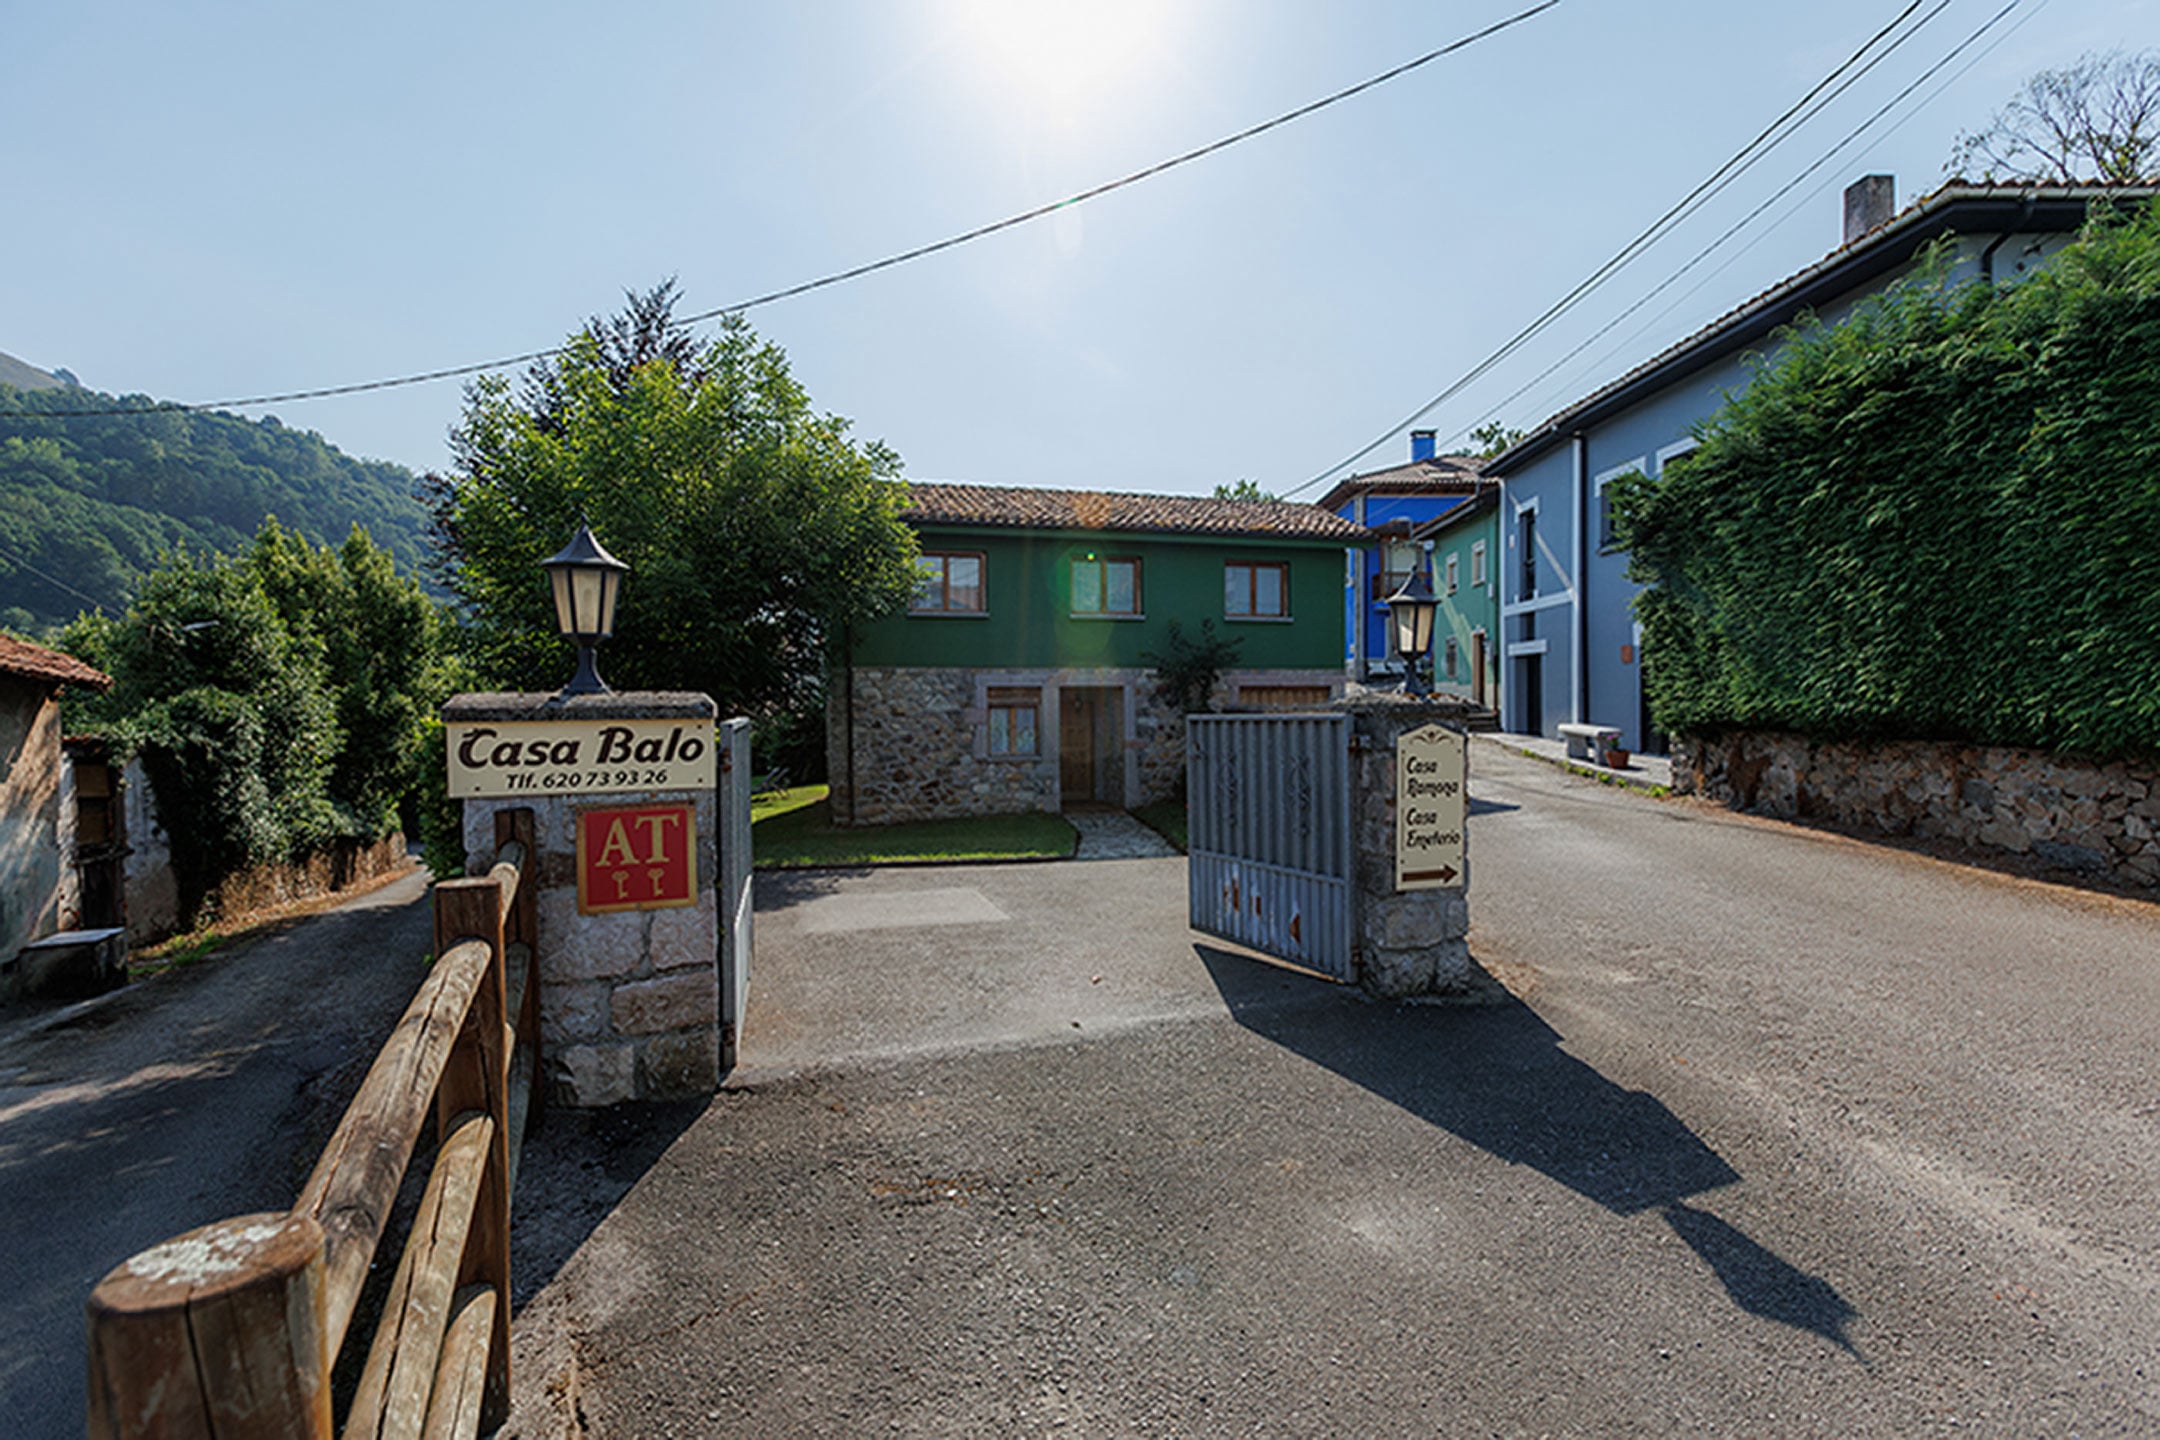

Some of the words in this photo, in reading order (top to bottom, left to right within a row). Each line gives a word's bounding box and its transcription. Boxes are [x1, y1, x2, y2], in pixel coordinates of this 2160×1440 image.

[458, 727, 581, 769] Casa
[596, 726, 705, 764] Balo
[1407, 756, 1437, 774] Casa
[507, 772, 537, 789] Tlf.
[543, 772, 582, 788] 620
[585, 771, 610, 786] 73
[614, 770, 639, 785] 93
[643, 769, 668, 784] 26
[1407, 807, 1437, 826] Casa
[595, 814, 680, 867] AT
